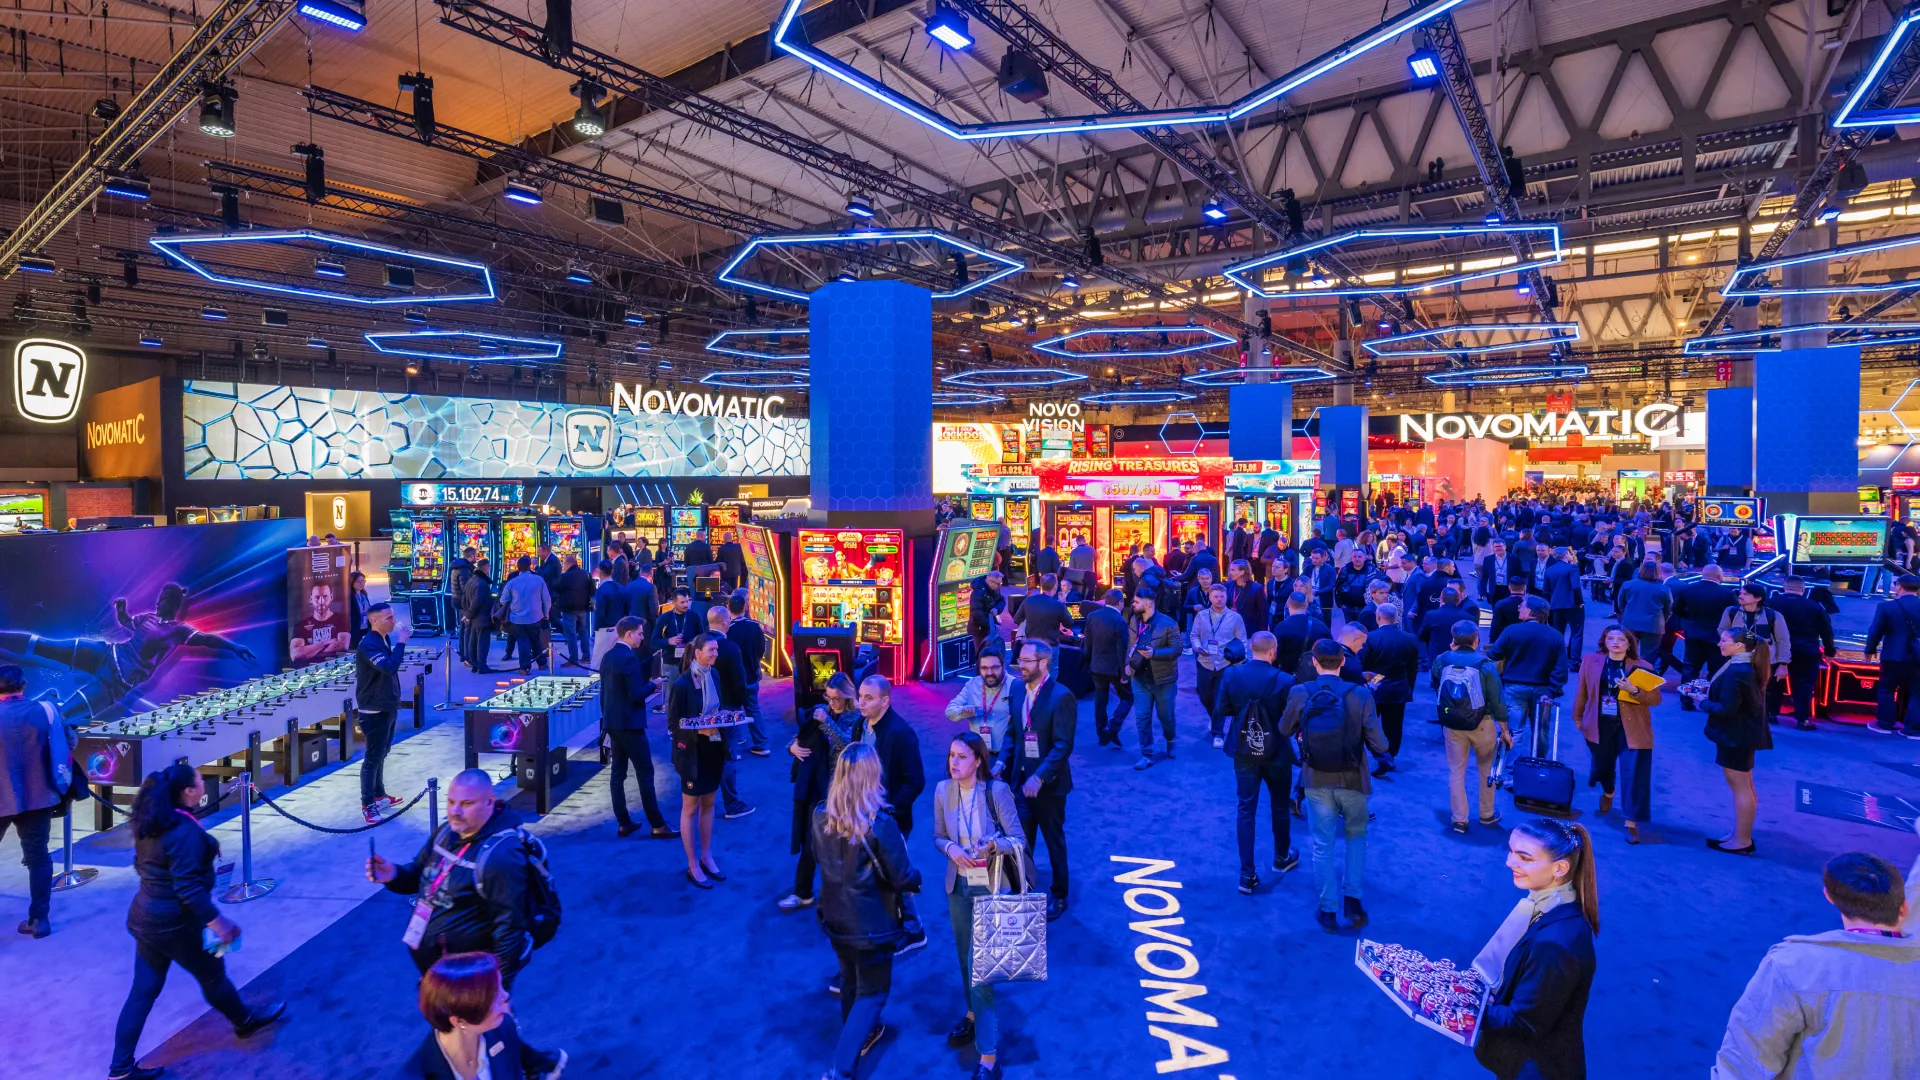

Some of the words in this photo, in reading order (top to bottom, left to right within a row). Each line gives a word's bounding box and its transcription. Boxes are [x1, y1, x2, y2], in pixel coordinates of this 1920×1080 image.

[26, 358, 76, 399] N
[612, 382, 785, 423] NOVOMATIC
[1029, 403, 1080, 417] NOVO
[87, 412, 145, 450] NOVOMATIC
[1022, 418, 1085, 432] VISION
[1400, 403, 1680, 443] NOVOMATIC
[573, 424, 607, 453] N
[1067, 459, 1113, 474] RISING
[1117, 459, 1200, 474] TREASURES
[441, 487, 500, 502] 15.102,74
[336, 505, 344, 520] N
[1109, 855, 1238, 1080] NOVOMA
